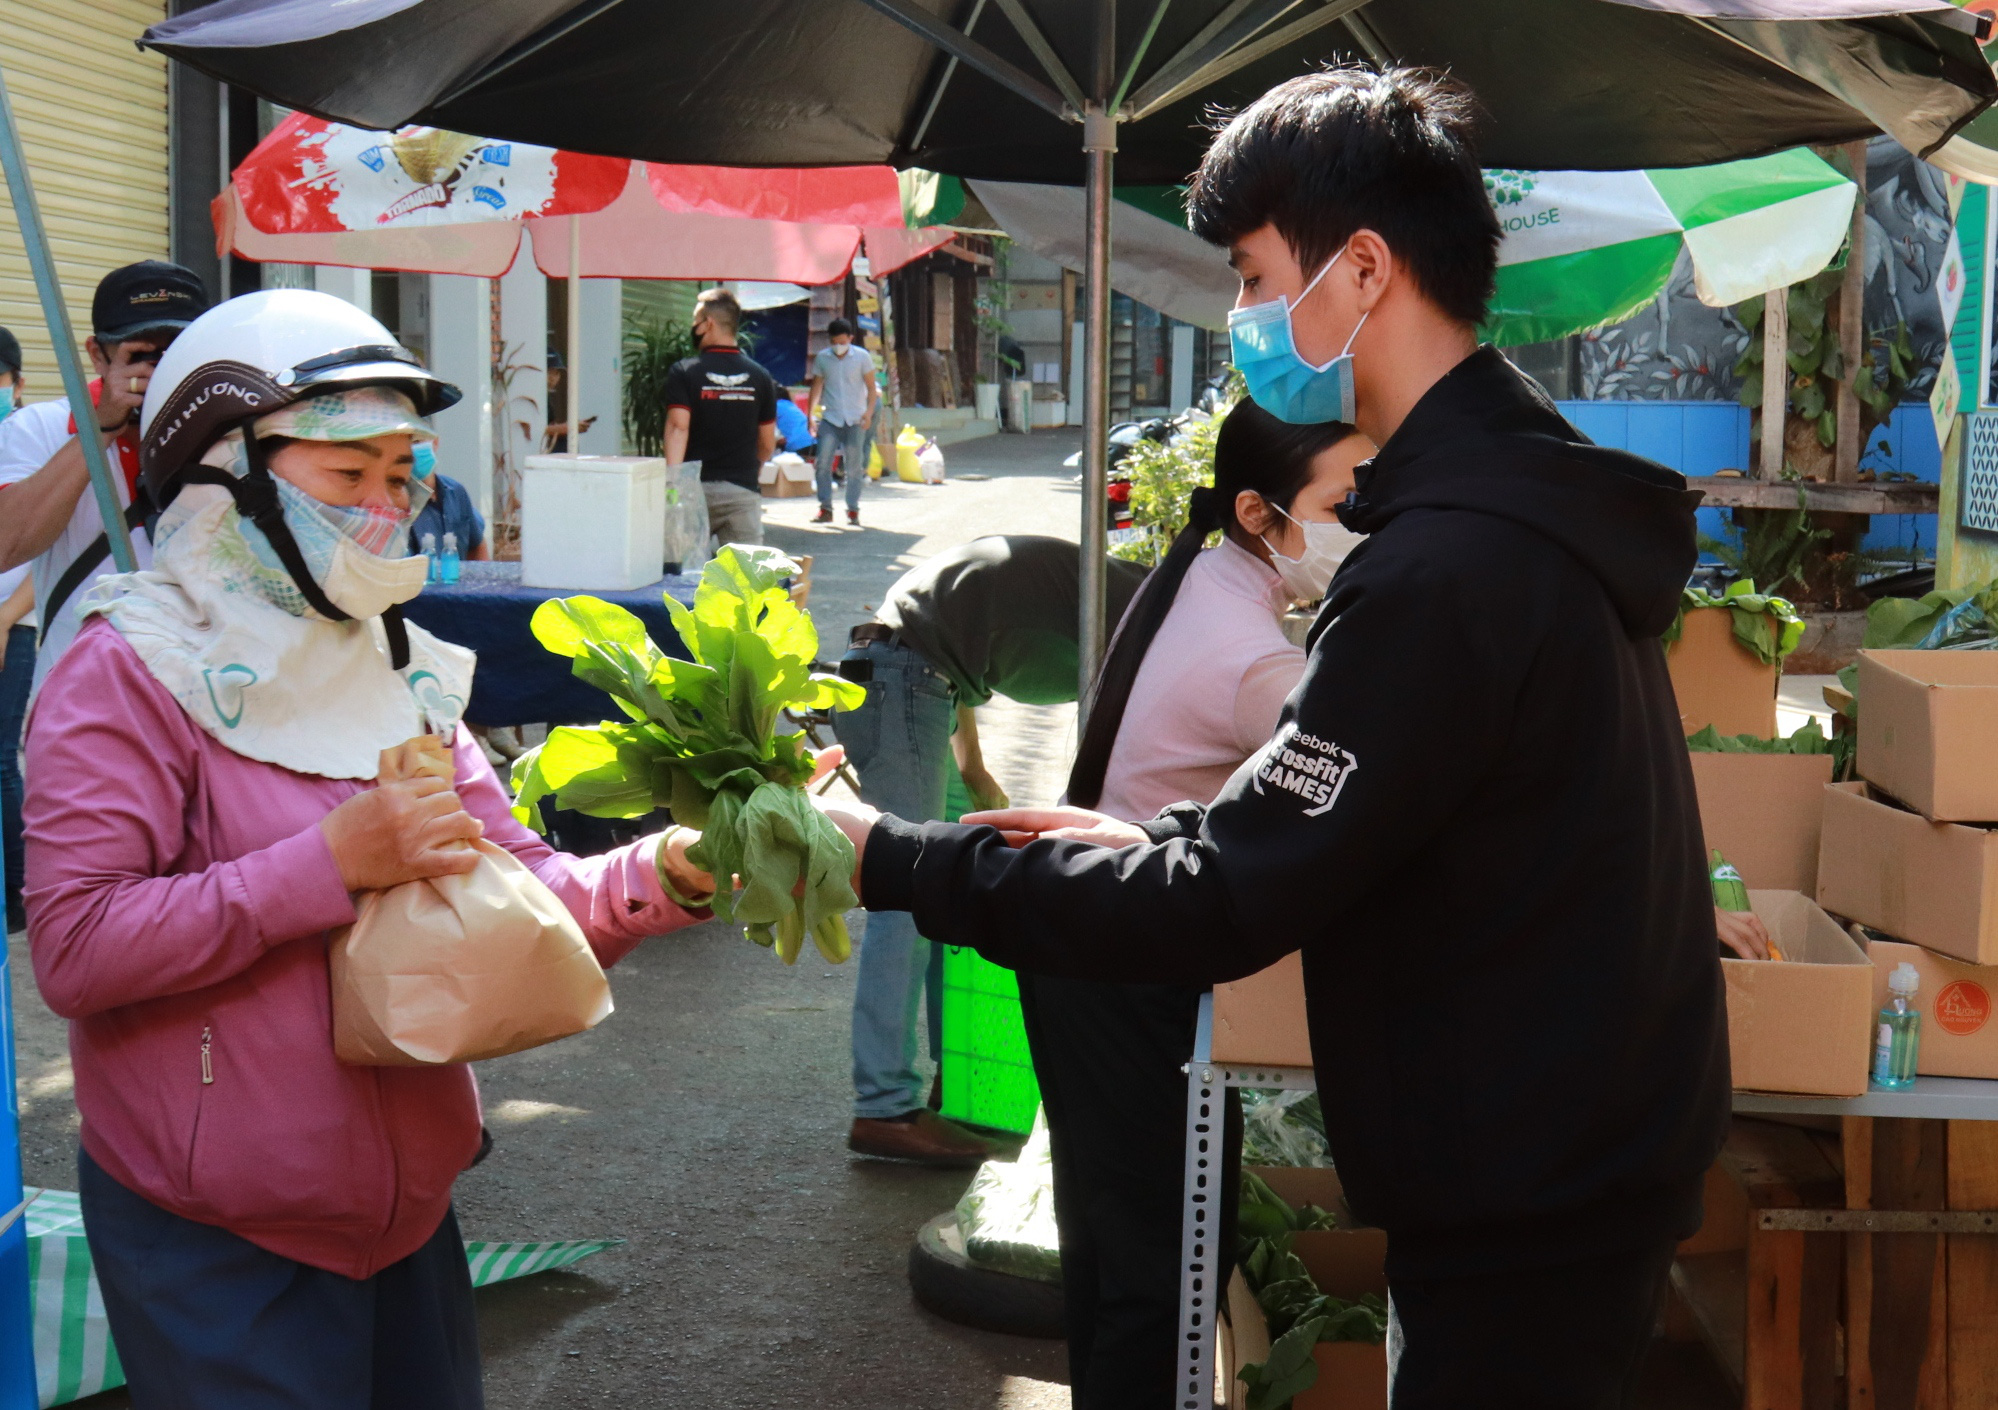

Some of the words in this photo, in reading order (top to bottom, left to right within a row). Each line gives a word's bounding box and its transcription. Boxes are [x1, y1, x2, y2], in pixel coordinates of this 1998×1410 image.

[386, 183, 447, 219] TORNADO
[159, 418, 182, 447] LAI
[1258, 758, 1333, 805] GAMES
